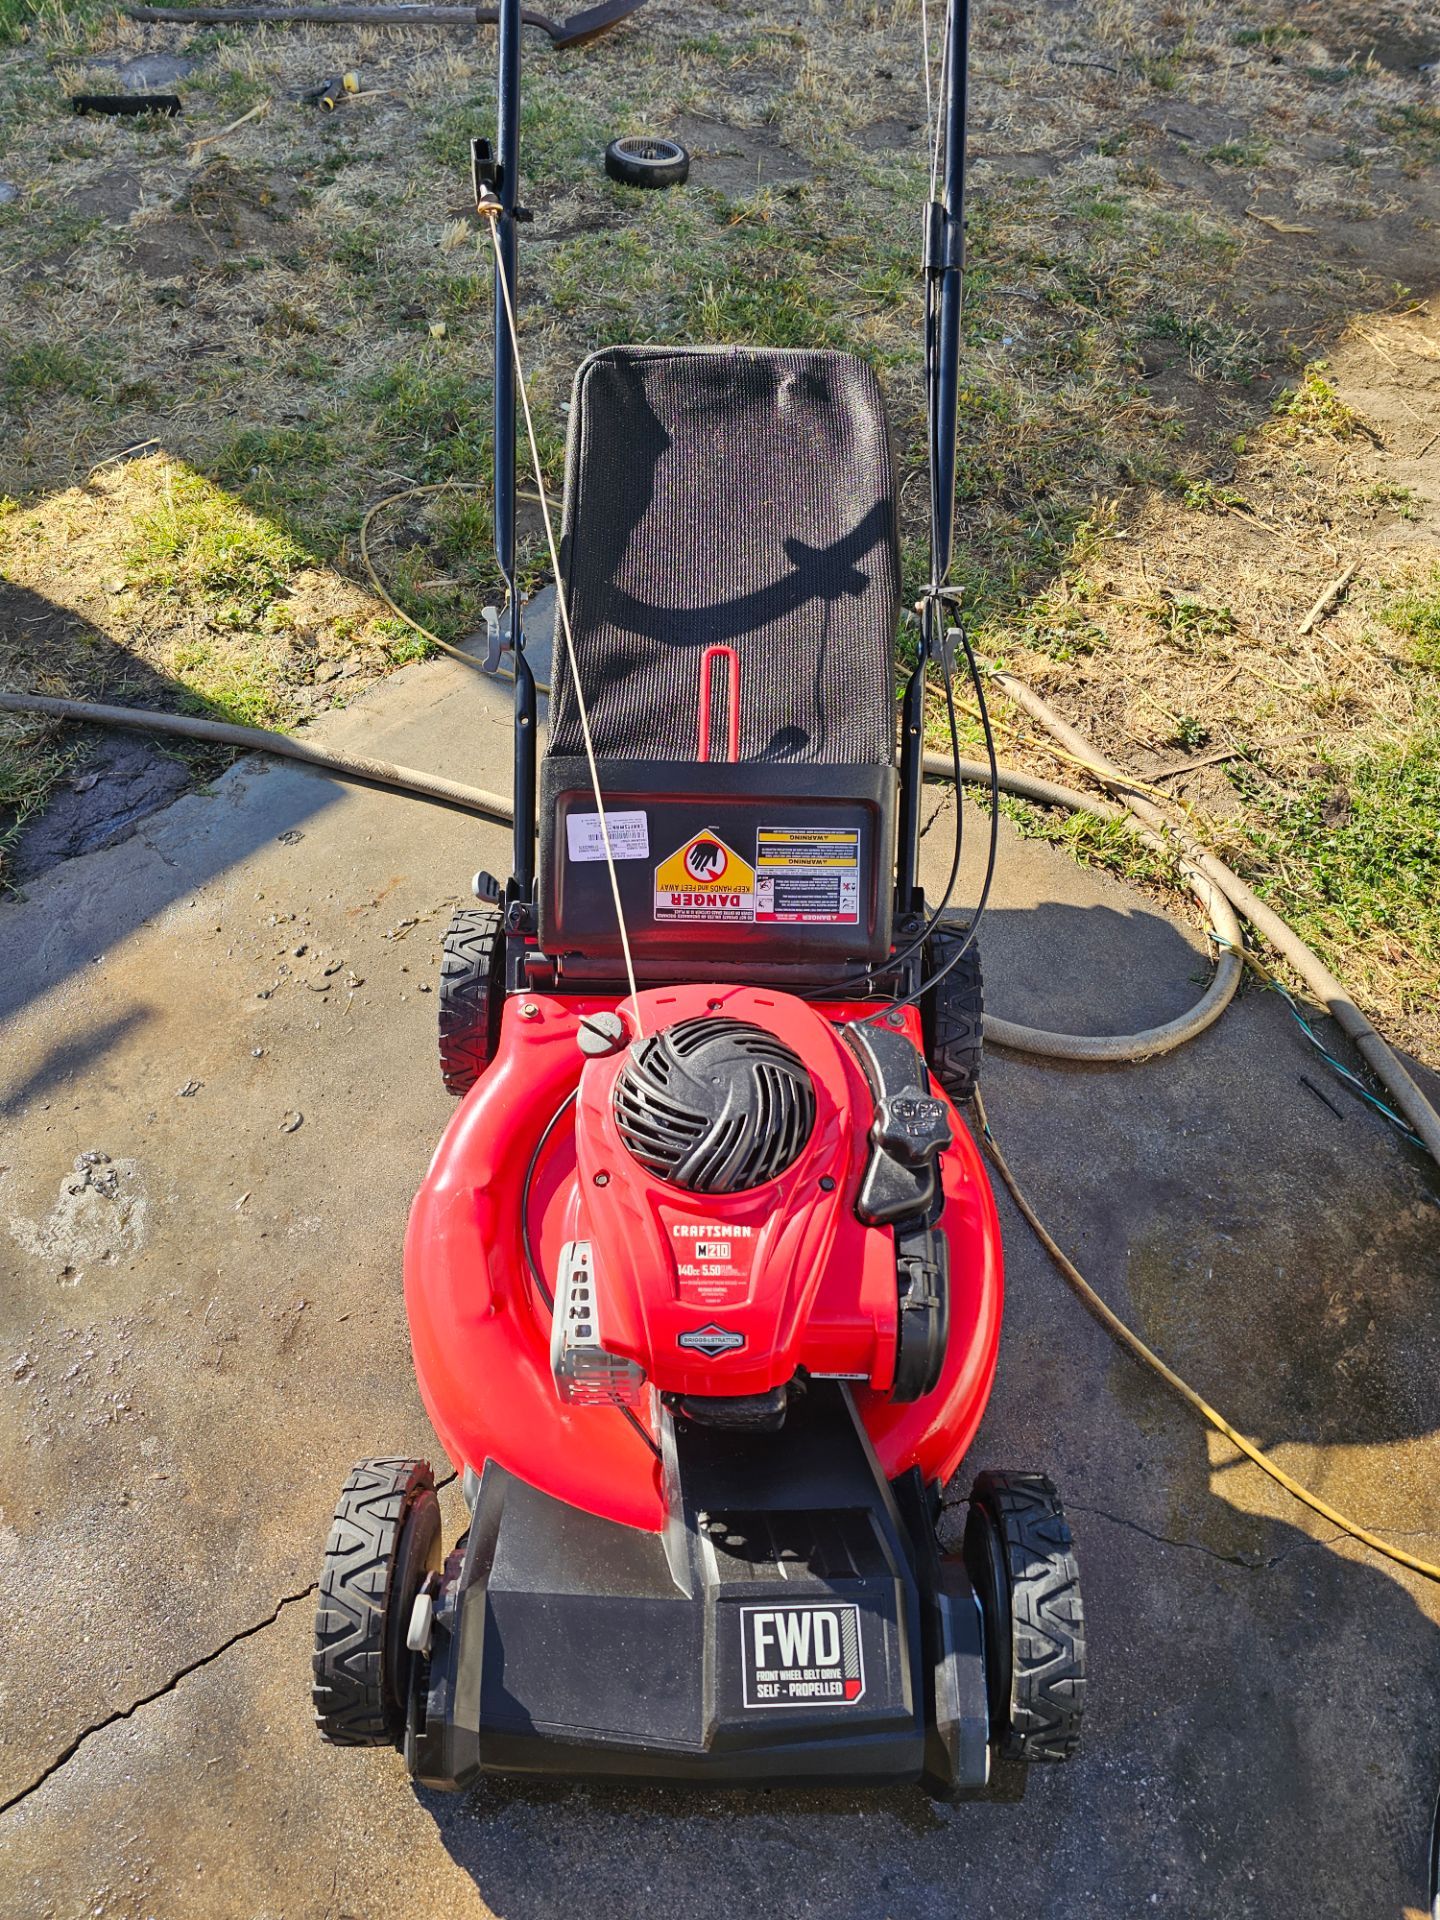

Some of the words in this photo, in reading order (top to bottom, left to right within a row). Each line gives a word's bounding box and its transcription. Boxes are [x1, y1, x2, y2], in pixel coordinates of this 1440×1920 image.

[671, 894, 740, 907] DANGER
[673, 1225, 751, 1237] CRAFTSMAN
[698, 1244, 729, 1257] M210
[702, 1264, 720, 1276] 5.50
[753, 1611, 841, 1668] FWD
[756, 1670, 779, 1681] FRONT
[779, 1670, 802, 1681] WHEEL
[803, 1669, 820, 1680] BELT
[821, 1669, 842, 1679] DRIVE
[757, 1684, 781, 1698] SELF
[789, 1682, 843, 1697] PROPELLED
